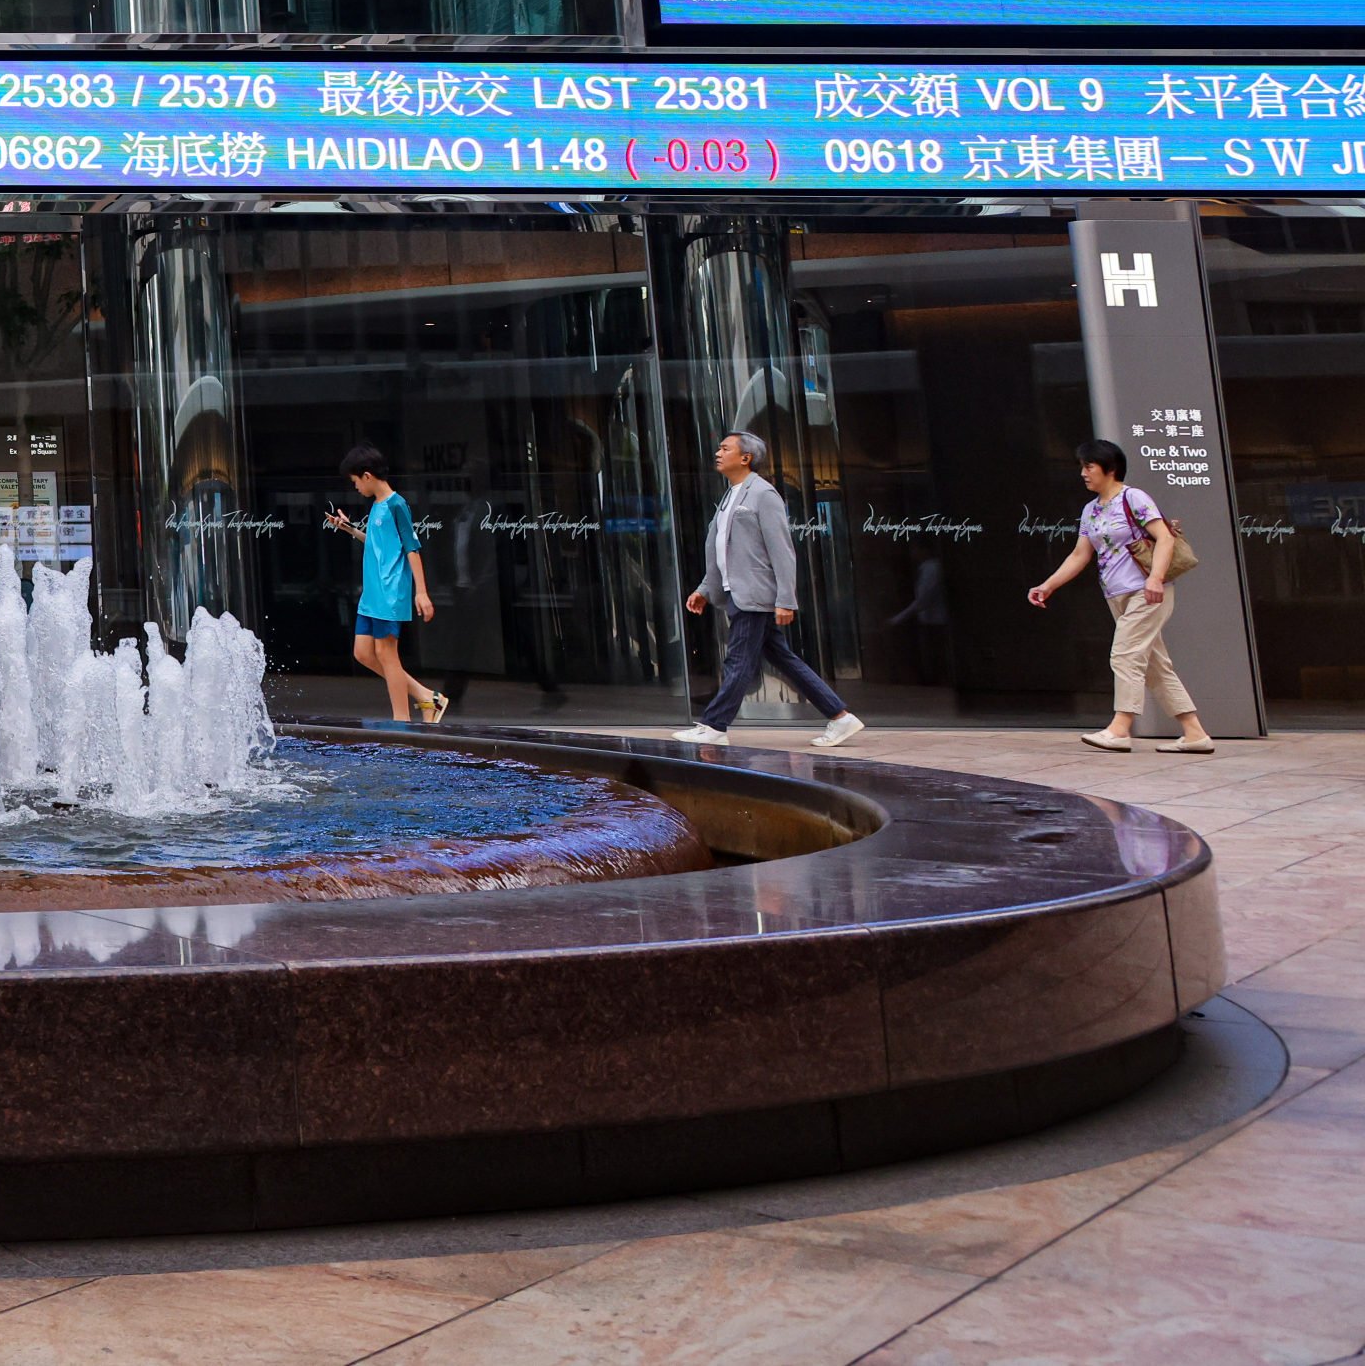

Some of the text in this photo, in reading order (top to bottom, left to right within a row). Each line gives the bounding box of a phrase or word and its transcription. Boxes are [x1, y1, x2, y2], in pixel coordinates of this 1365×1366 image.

[0, 74, 115, 107] 25383
[159, 75, 276, 108] 25376
[318, 71, 512, 116] 最後成交
[534, 77, 637, 109] LAST
[655, 77, 766, 110] 25381
[816, 73, 960, 118] 成交額
[977, 78, 1064, 111] VOL
[1080, 79, 1103, 111] 9
[121, 132, 267, 177] 海底撈
[288, 138, 483, 171] HAIDILAO
[504, 138, 607, 171] 11.48
[825, 139, 943, 172] 09618
[1151, 409, 1201, 421] 交易廣場
[1141, 446, 1206, 457] One & Two
[1150, 460, 1208, 473] Exchange
[1167, 474, 1210, 487] Square
